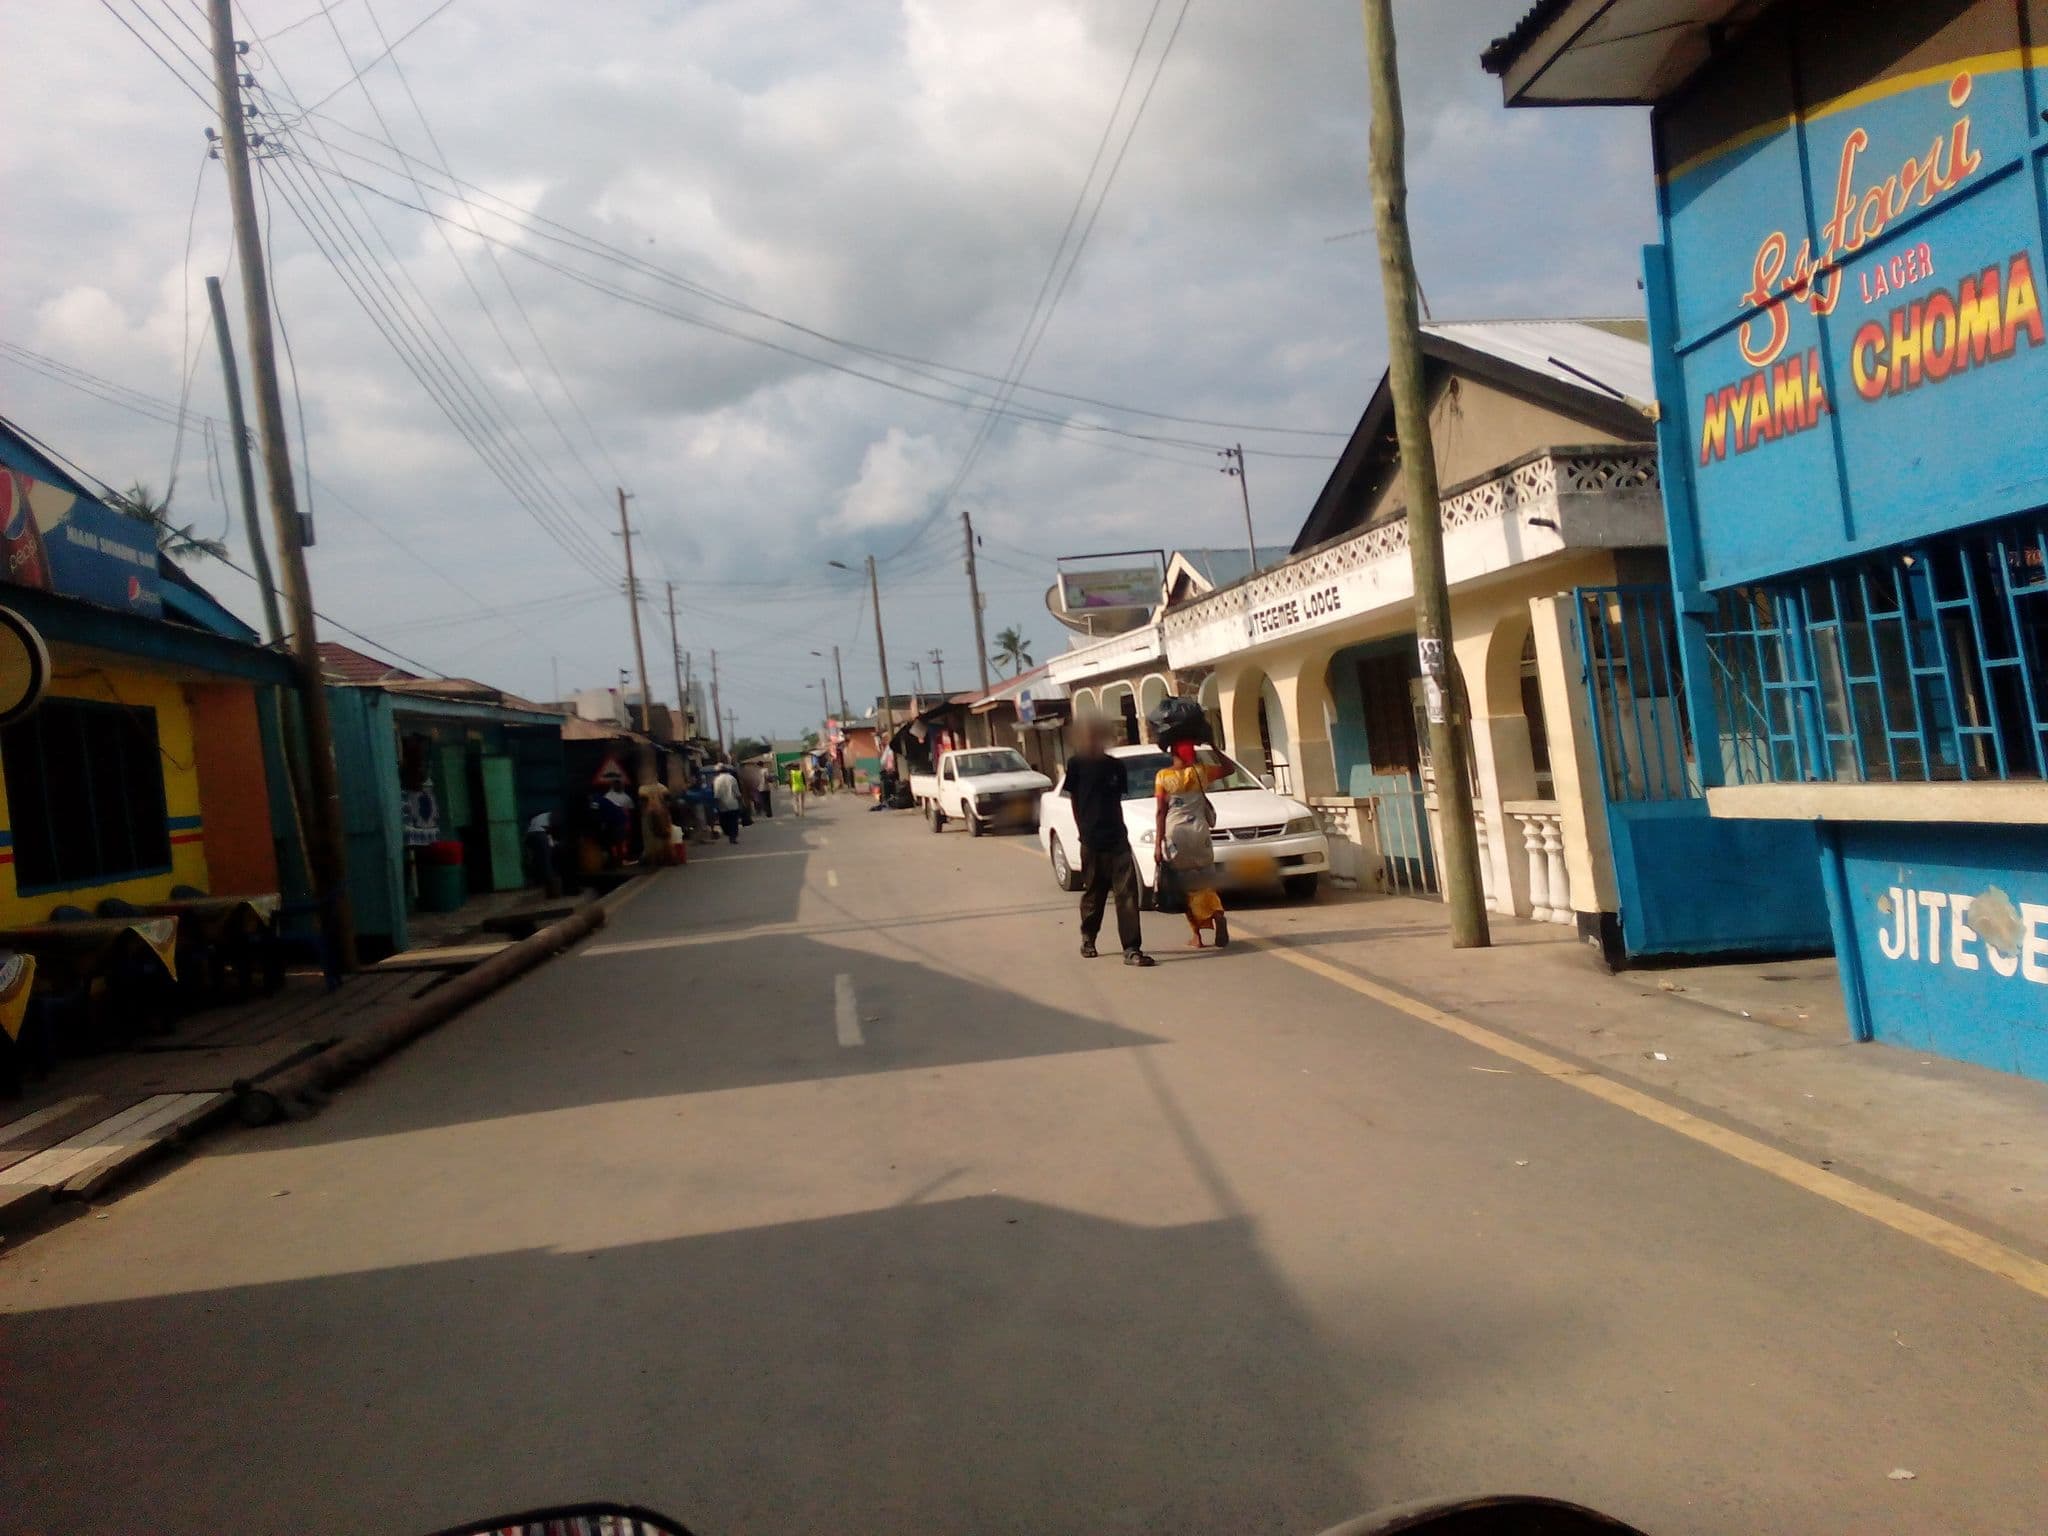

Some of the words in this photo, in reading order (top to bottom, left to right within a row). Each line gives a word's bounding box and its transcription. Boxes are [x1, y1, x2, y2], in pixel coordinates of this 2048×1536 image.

[1738, 71, 1984, 368] Safari
[1859, 242, 1935, 305] LAGER
[1700, 346, 1834, 468] NYAMA
[1850, 250, 2047, 402] CHOMA
